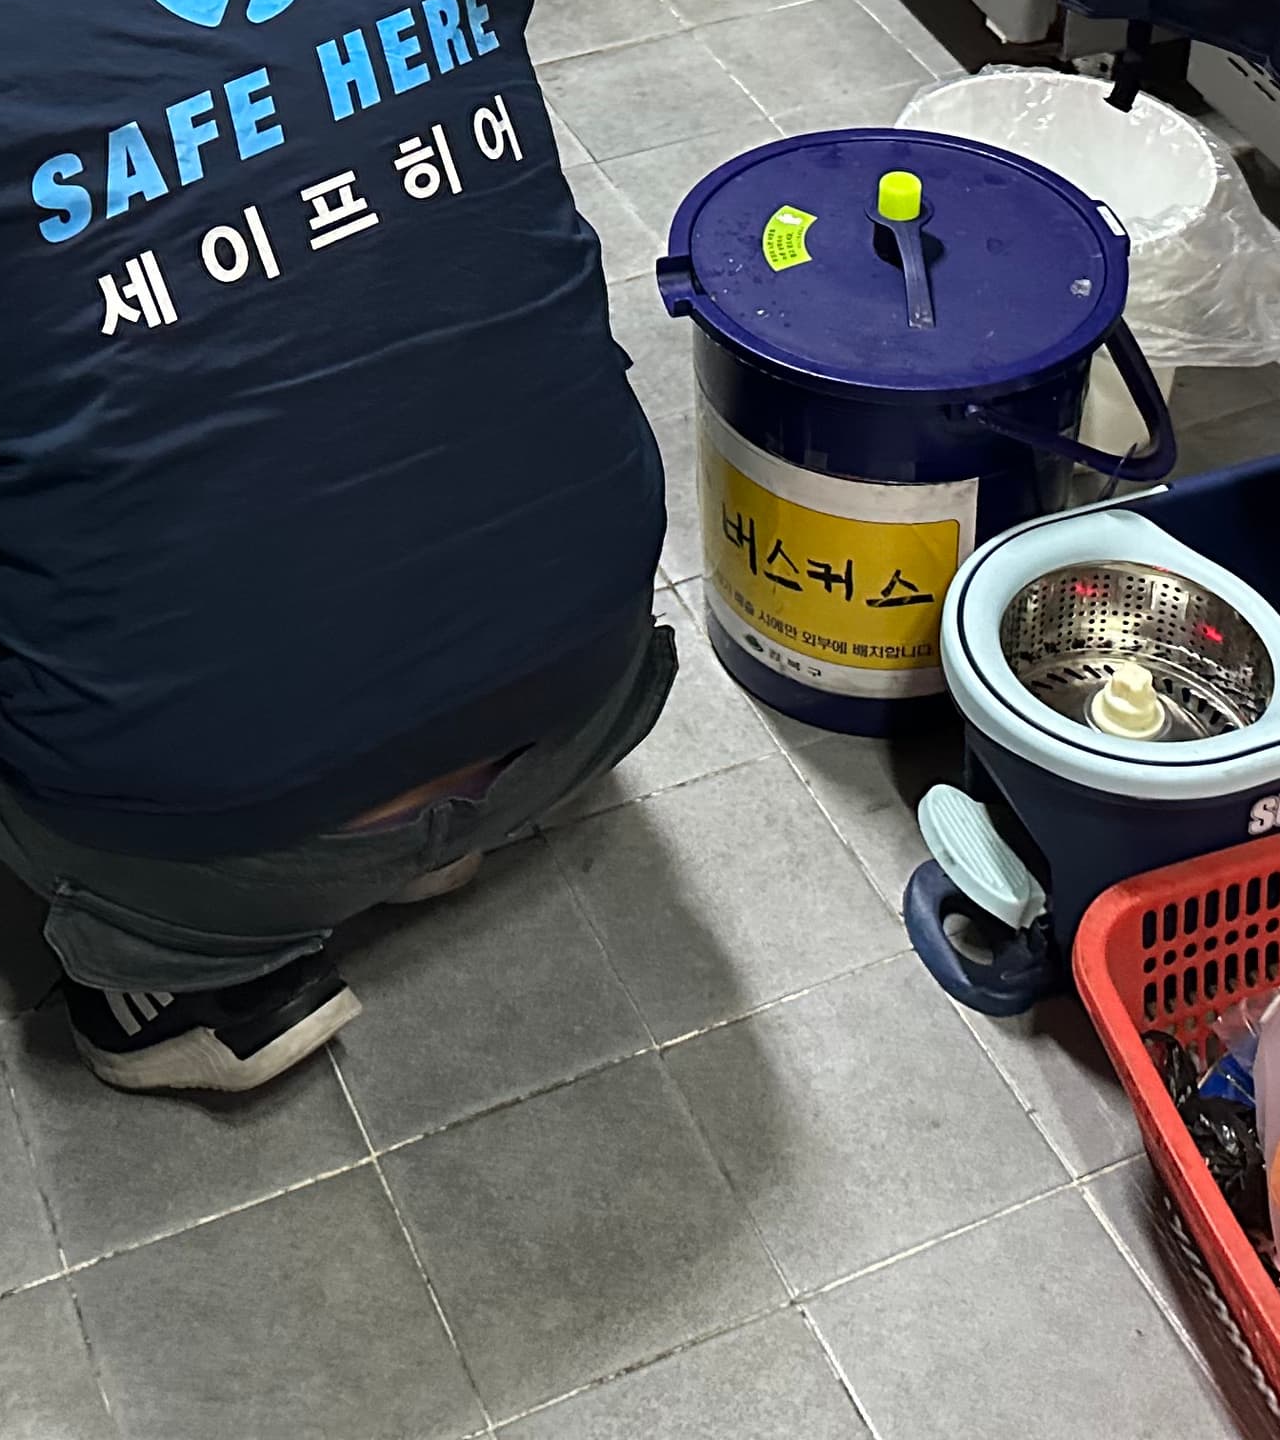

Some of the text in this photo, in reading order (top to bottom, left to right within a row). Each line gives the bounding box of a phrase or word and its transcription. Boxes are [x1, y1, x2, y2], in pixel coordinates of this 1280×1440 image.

[30, 66, 285, 244] SAFE
[758, 609, 798, 639] 시에만
[802, 629, 848, 657] 외부에
